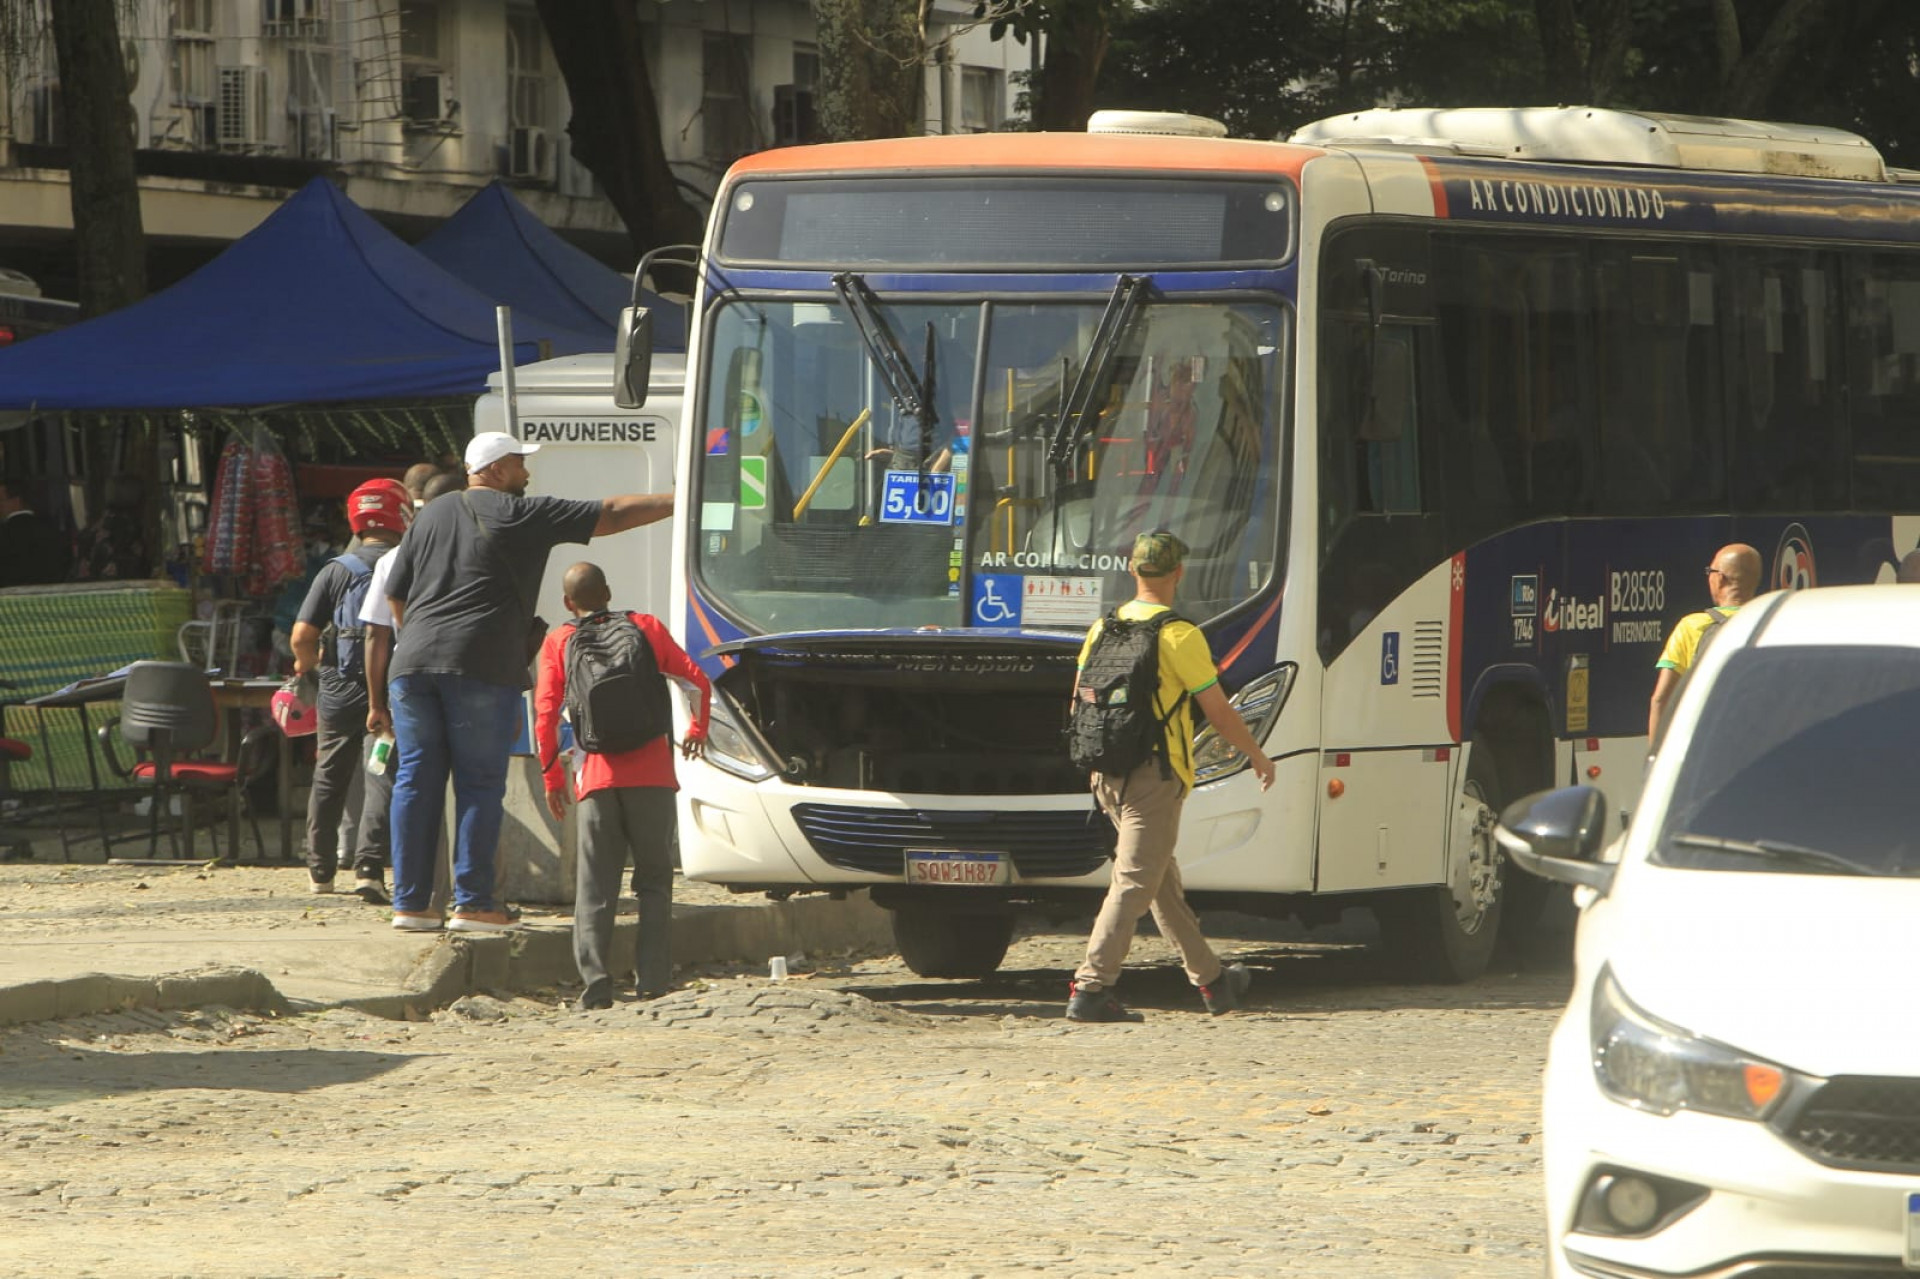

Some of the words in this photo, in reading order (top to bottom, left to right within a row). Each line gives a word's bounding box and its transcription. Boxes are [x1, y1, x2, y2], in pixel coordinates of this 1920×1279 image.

[1470, 178, 1497, 211] AR
[1501, 181, 1665, 220] CONDICIONADO
[1379, 267, 1426, 284] Torino
[523, 422, 656, 441] PAVUNENSE
[890, 475, 931, 485] TARIA
[886, 488, 949, 519] 5,00
[981, 551, 1007, 567] AR
[1611, 570, 1665, 612] B28568
[1560, 595, 1604, 630] ideal
[1514, 618, 1534, 640] 1746
[1613, 621, 1662, 643] INTERNORTE
[917, 862, 997, 882] SQW1H87
